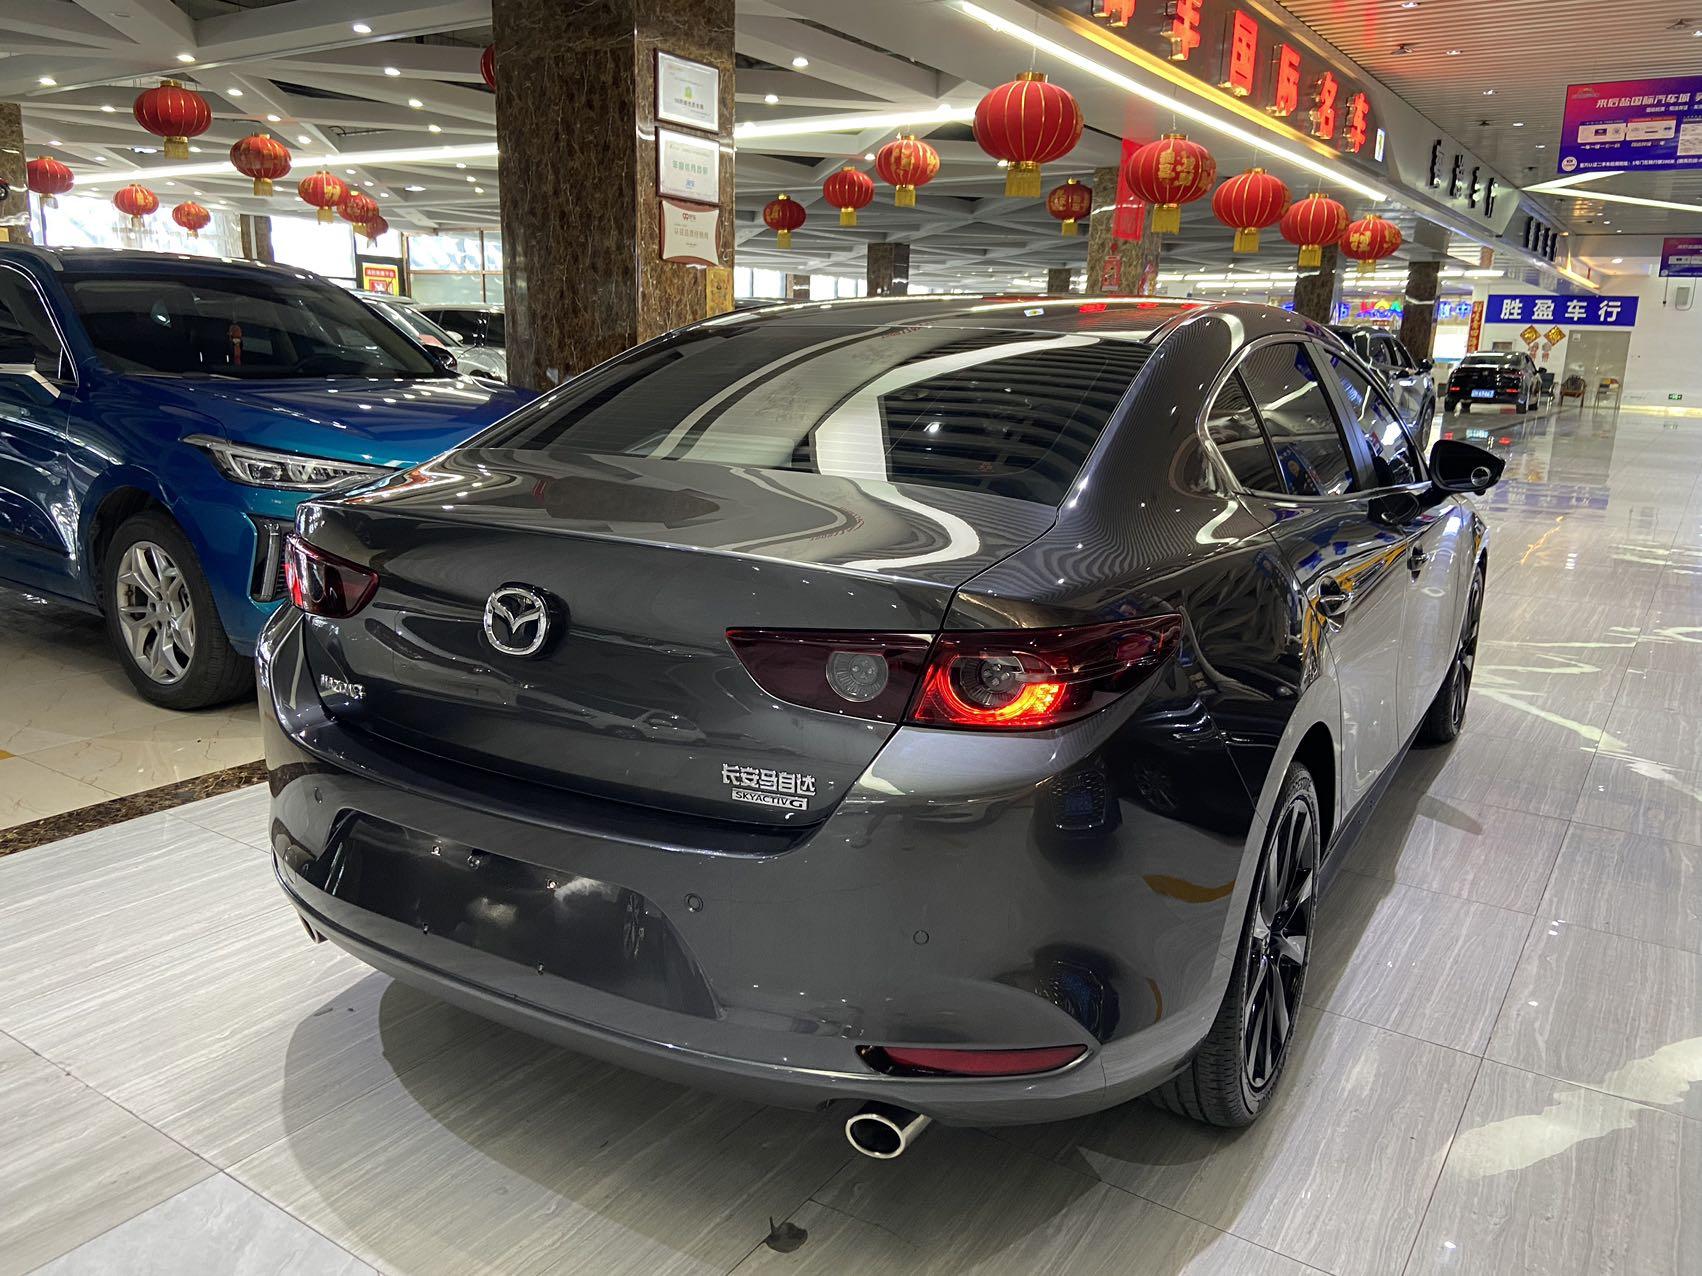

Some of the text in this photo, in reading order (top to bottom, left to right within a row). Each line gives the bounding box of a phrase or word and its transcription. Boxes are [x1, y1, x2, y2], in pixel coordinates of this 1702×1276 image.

[1500, 299, 1621, 321] 胜盈车行
[722, 763, 816, 796] 长安马自达
